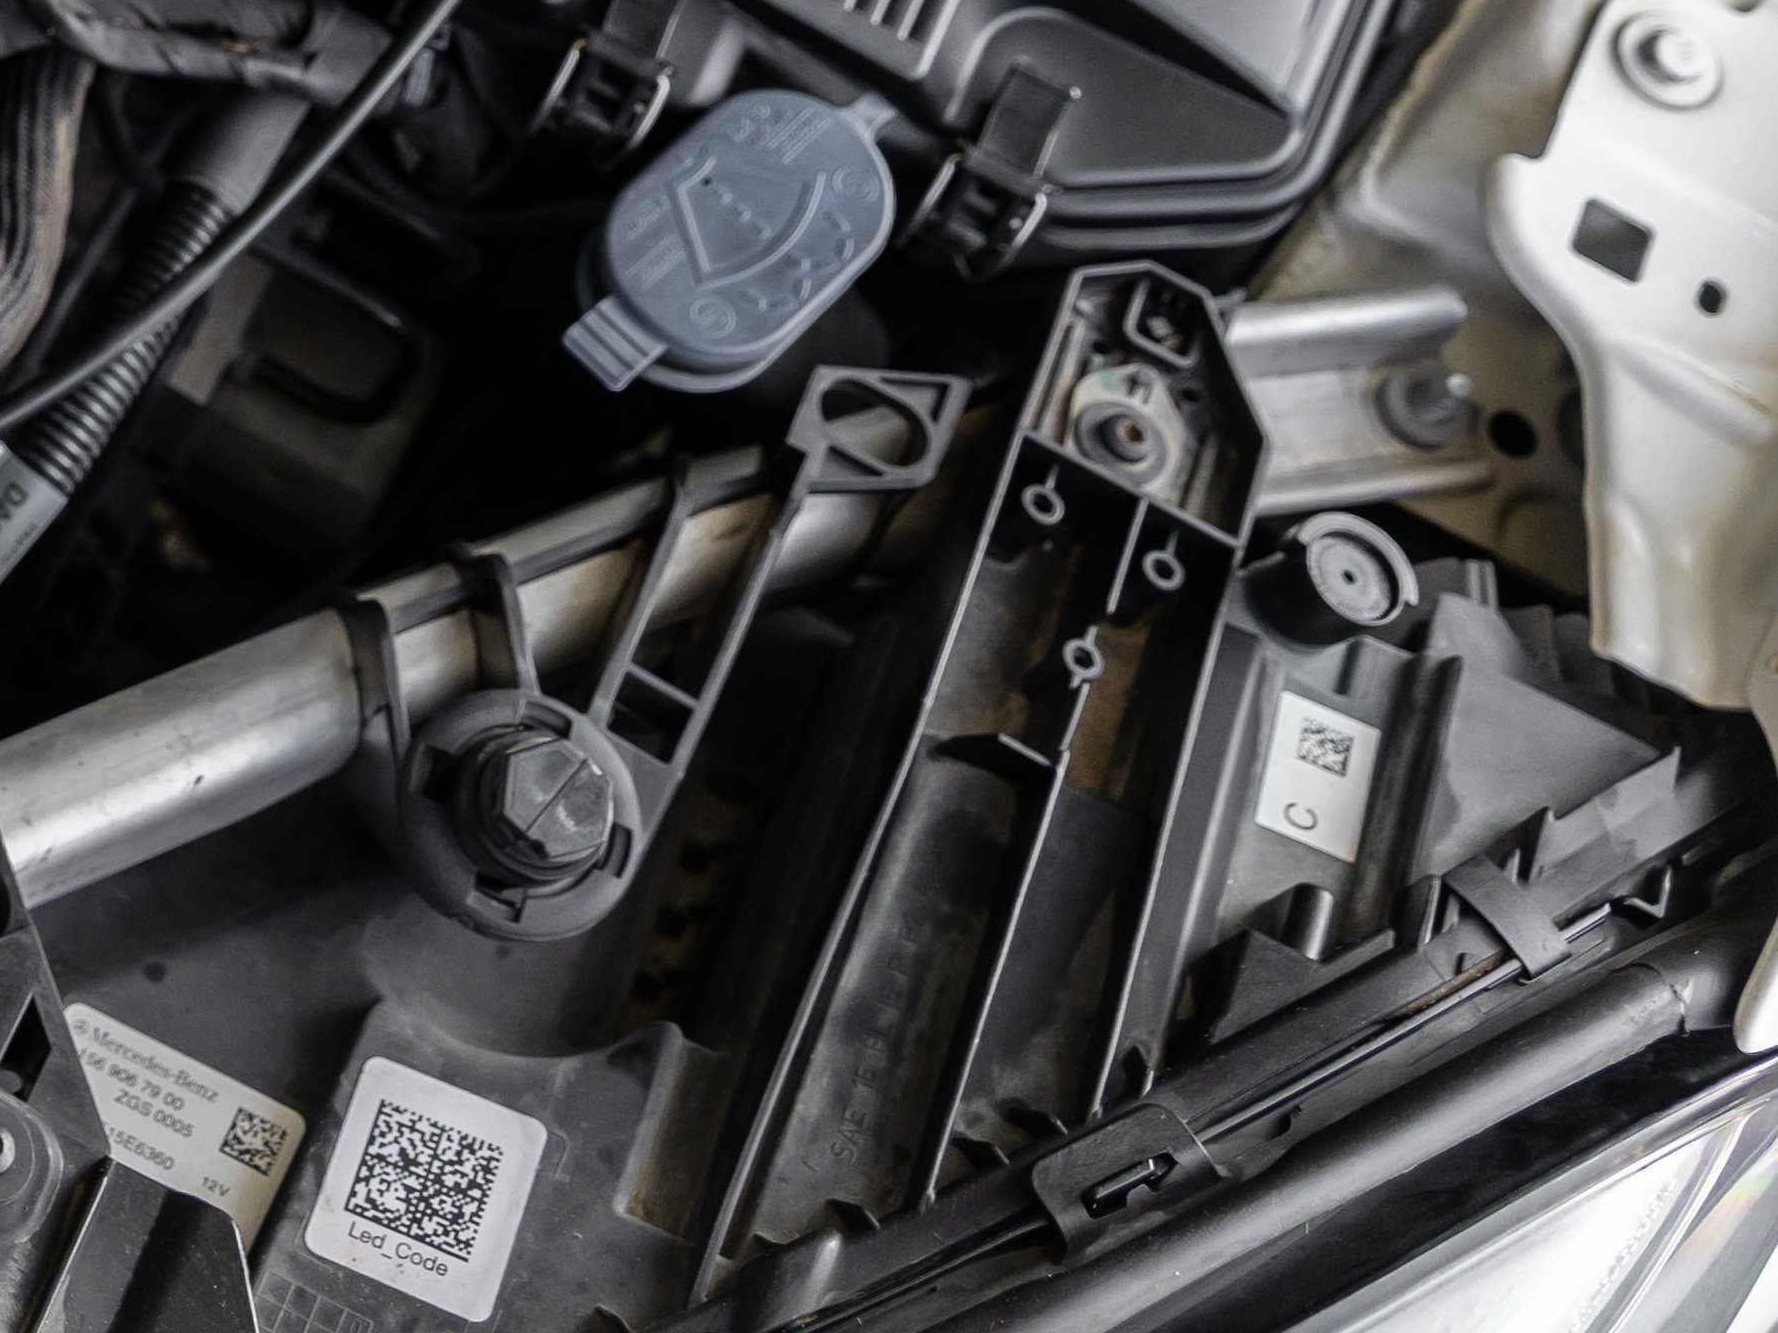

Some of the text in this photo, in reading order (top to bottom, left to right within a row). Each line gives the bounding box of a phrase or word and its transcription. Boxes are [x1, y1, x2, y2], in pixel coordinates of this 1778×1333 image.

[1284, 801, 1318, 830] C
[92, 1026, 220, 1104] Mercedes-Benz
[106, 1063, 140, 1088] 906
[140, 1079, 163, 1099] 79
[162, 1091, 186, 1112] 00
[113, 1088, 196, 1139] ZGS 0005
[201, 1176, 231, 1197] 12V
[348, 1221, 449, 1277] Led_Code
